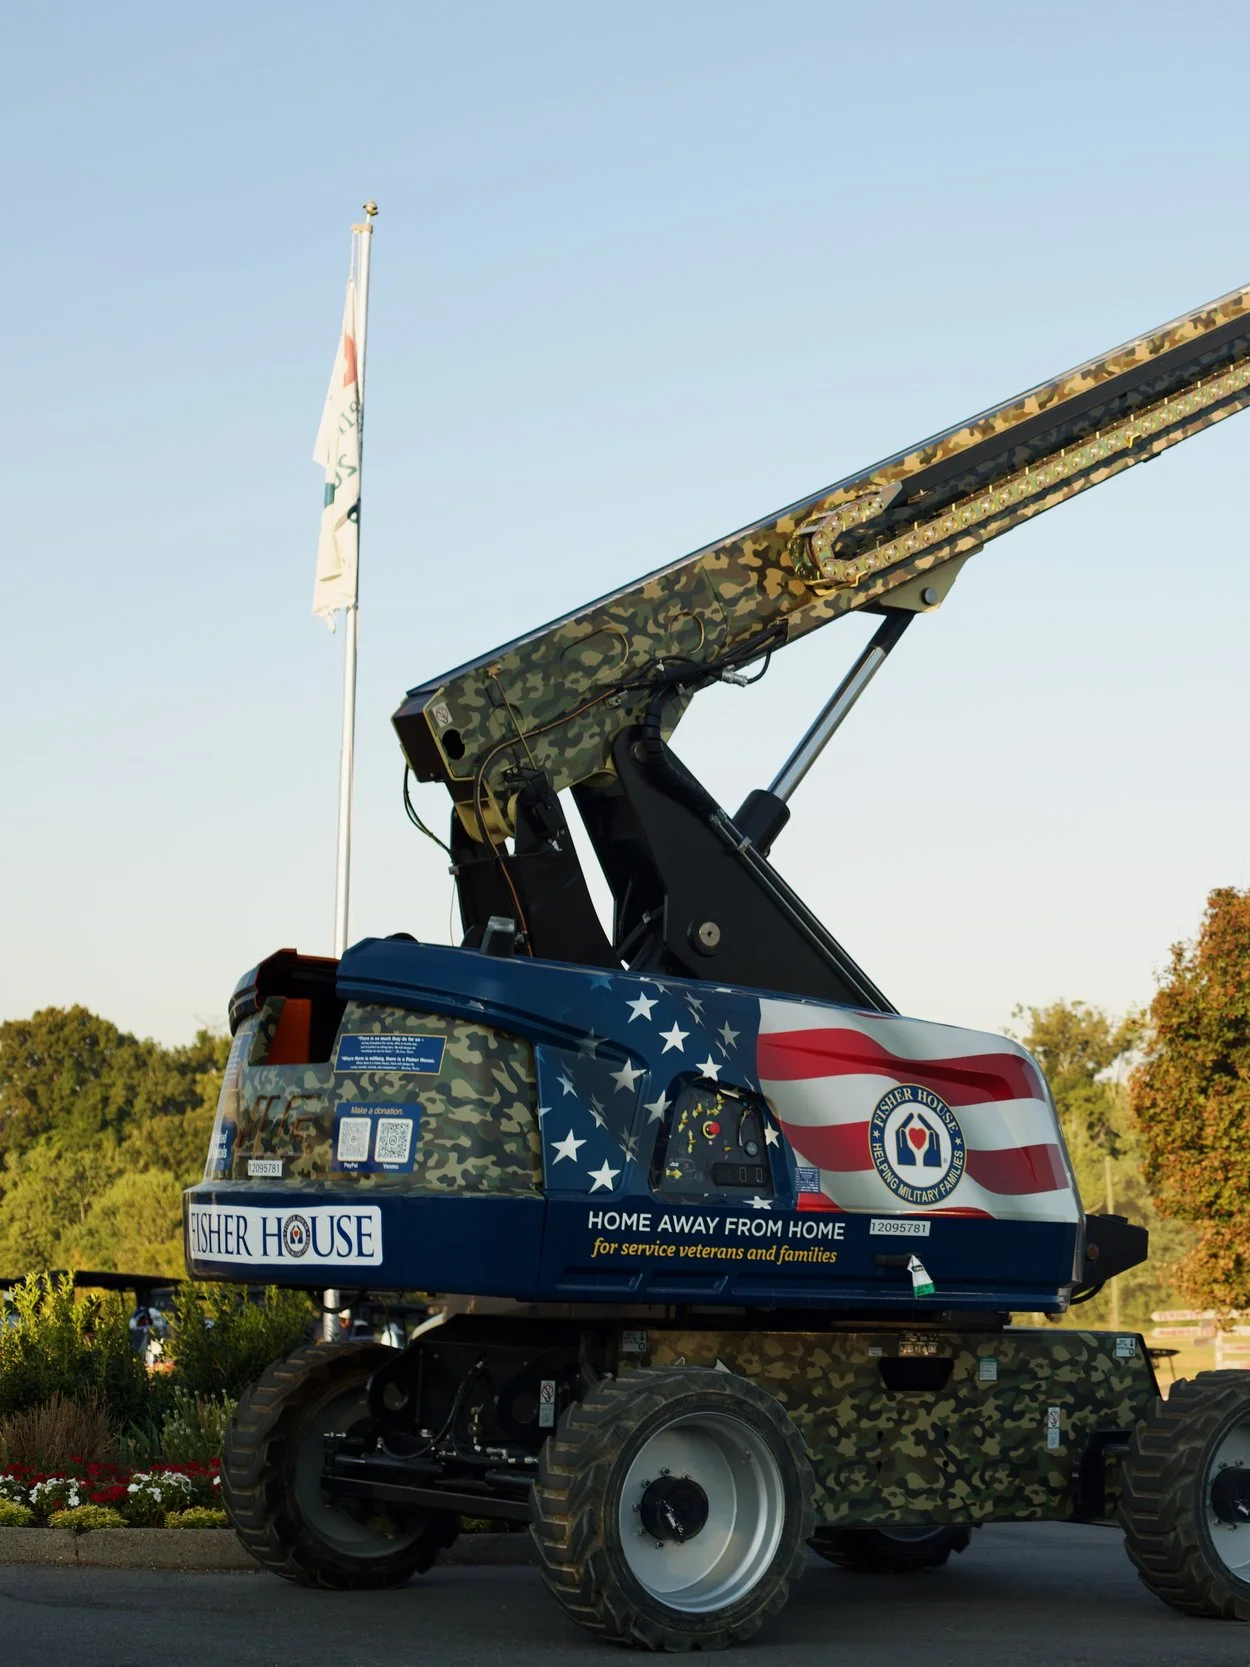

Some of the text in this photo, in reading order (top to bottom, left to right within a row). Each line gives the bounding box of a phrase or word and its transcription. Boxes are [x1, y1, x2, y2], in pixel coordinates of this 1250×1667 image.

[351, 1106, 366, 1114] Make
[874, 1087, 958, 1134] FISHER HOUSE
[248, 1161, 281, 1174] 12095781
[872, 1143, 899, 1188] HELPING
[898, 1183, 940, 1203] MILITARY
[940, 1150, 964, 1195] FAMILIES
[191, 1212, 253, 1257] FISHER
[588, 1211, 846, 1240] HOME AWAY FROM HOME
[871, 1221, 928, 1234] 12095781
[591, 1237, 837, 1265] for service veterans and families
